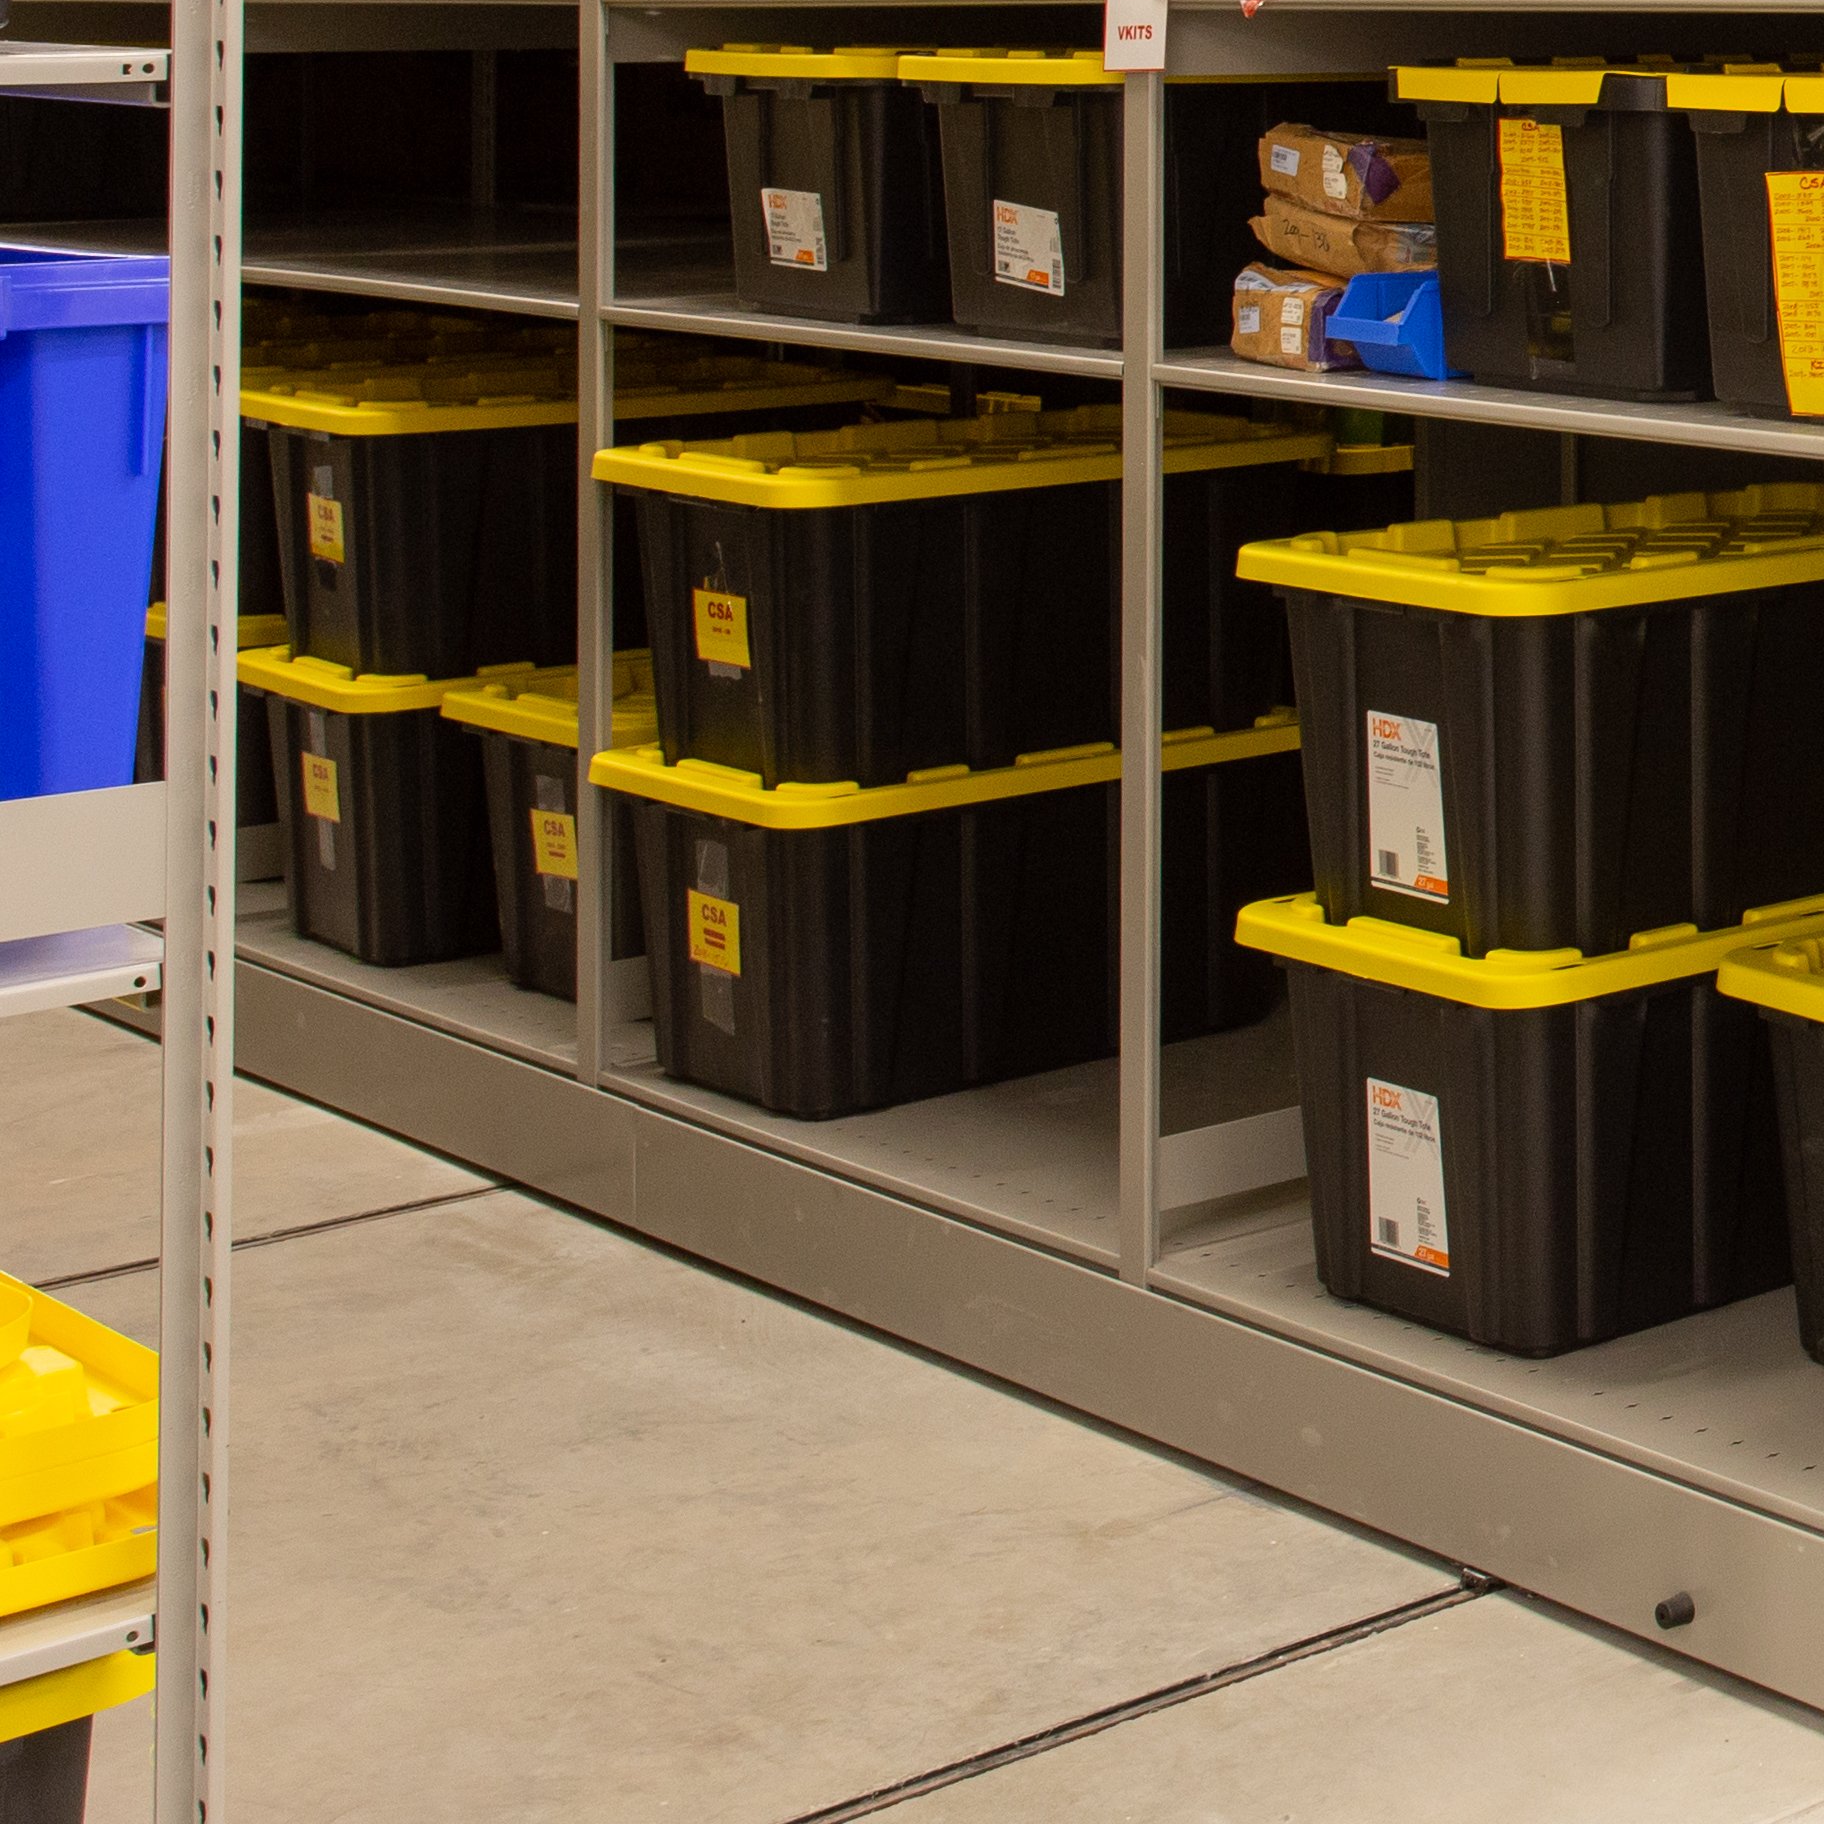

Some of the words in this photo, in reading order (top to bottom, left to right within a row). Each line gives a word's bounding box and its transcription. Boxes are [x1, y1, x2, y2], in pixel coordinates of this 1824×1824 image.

[1117, 24, 1153, 41] VKITS
[996, 206, 1018, 226] HDX
[707, 601, 734, 622] CSA
[1373, 717, 1402, 741] HDX
[1381, 741, 1400, 753] Gallon
[1400, 744, 1418, 758] Tough
[1417, 747, 1431, 759] Tote
[544, 819, 566, 837] CSA
[702, 904, 728, 928] CSA
[1373, 1085, 1401, 1110] HDX
[1381, 1109, 1400, 1122] Gallon
[1400, 1113, 1418, 1128] Tough
[1417, 1118, 1431, 1132] Tote
